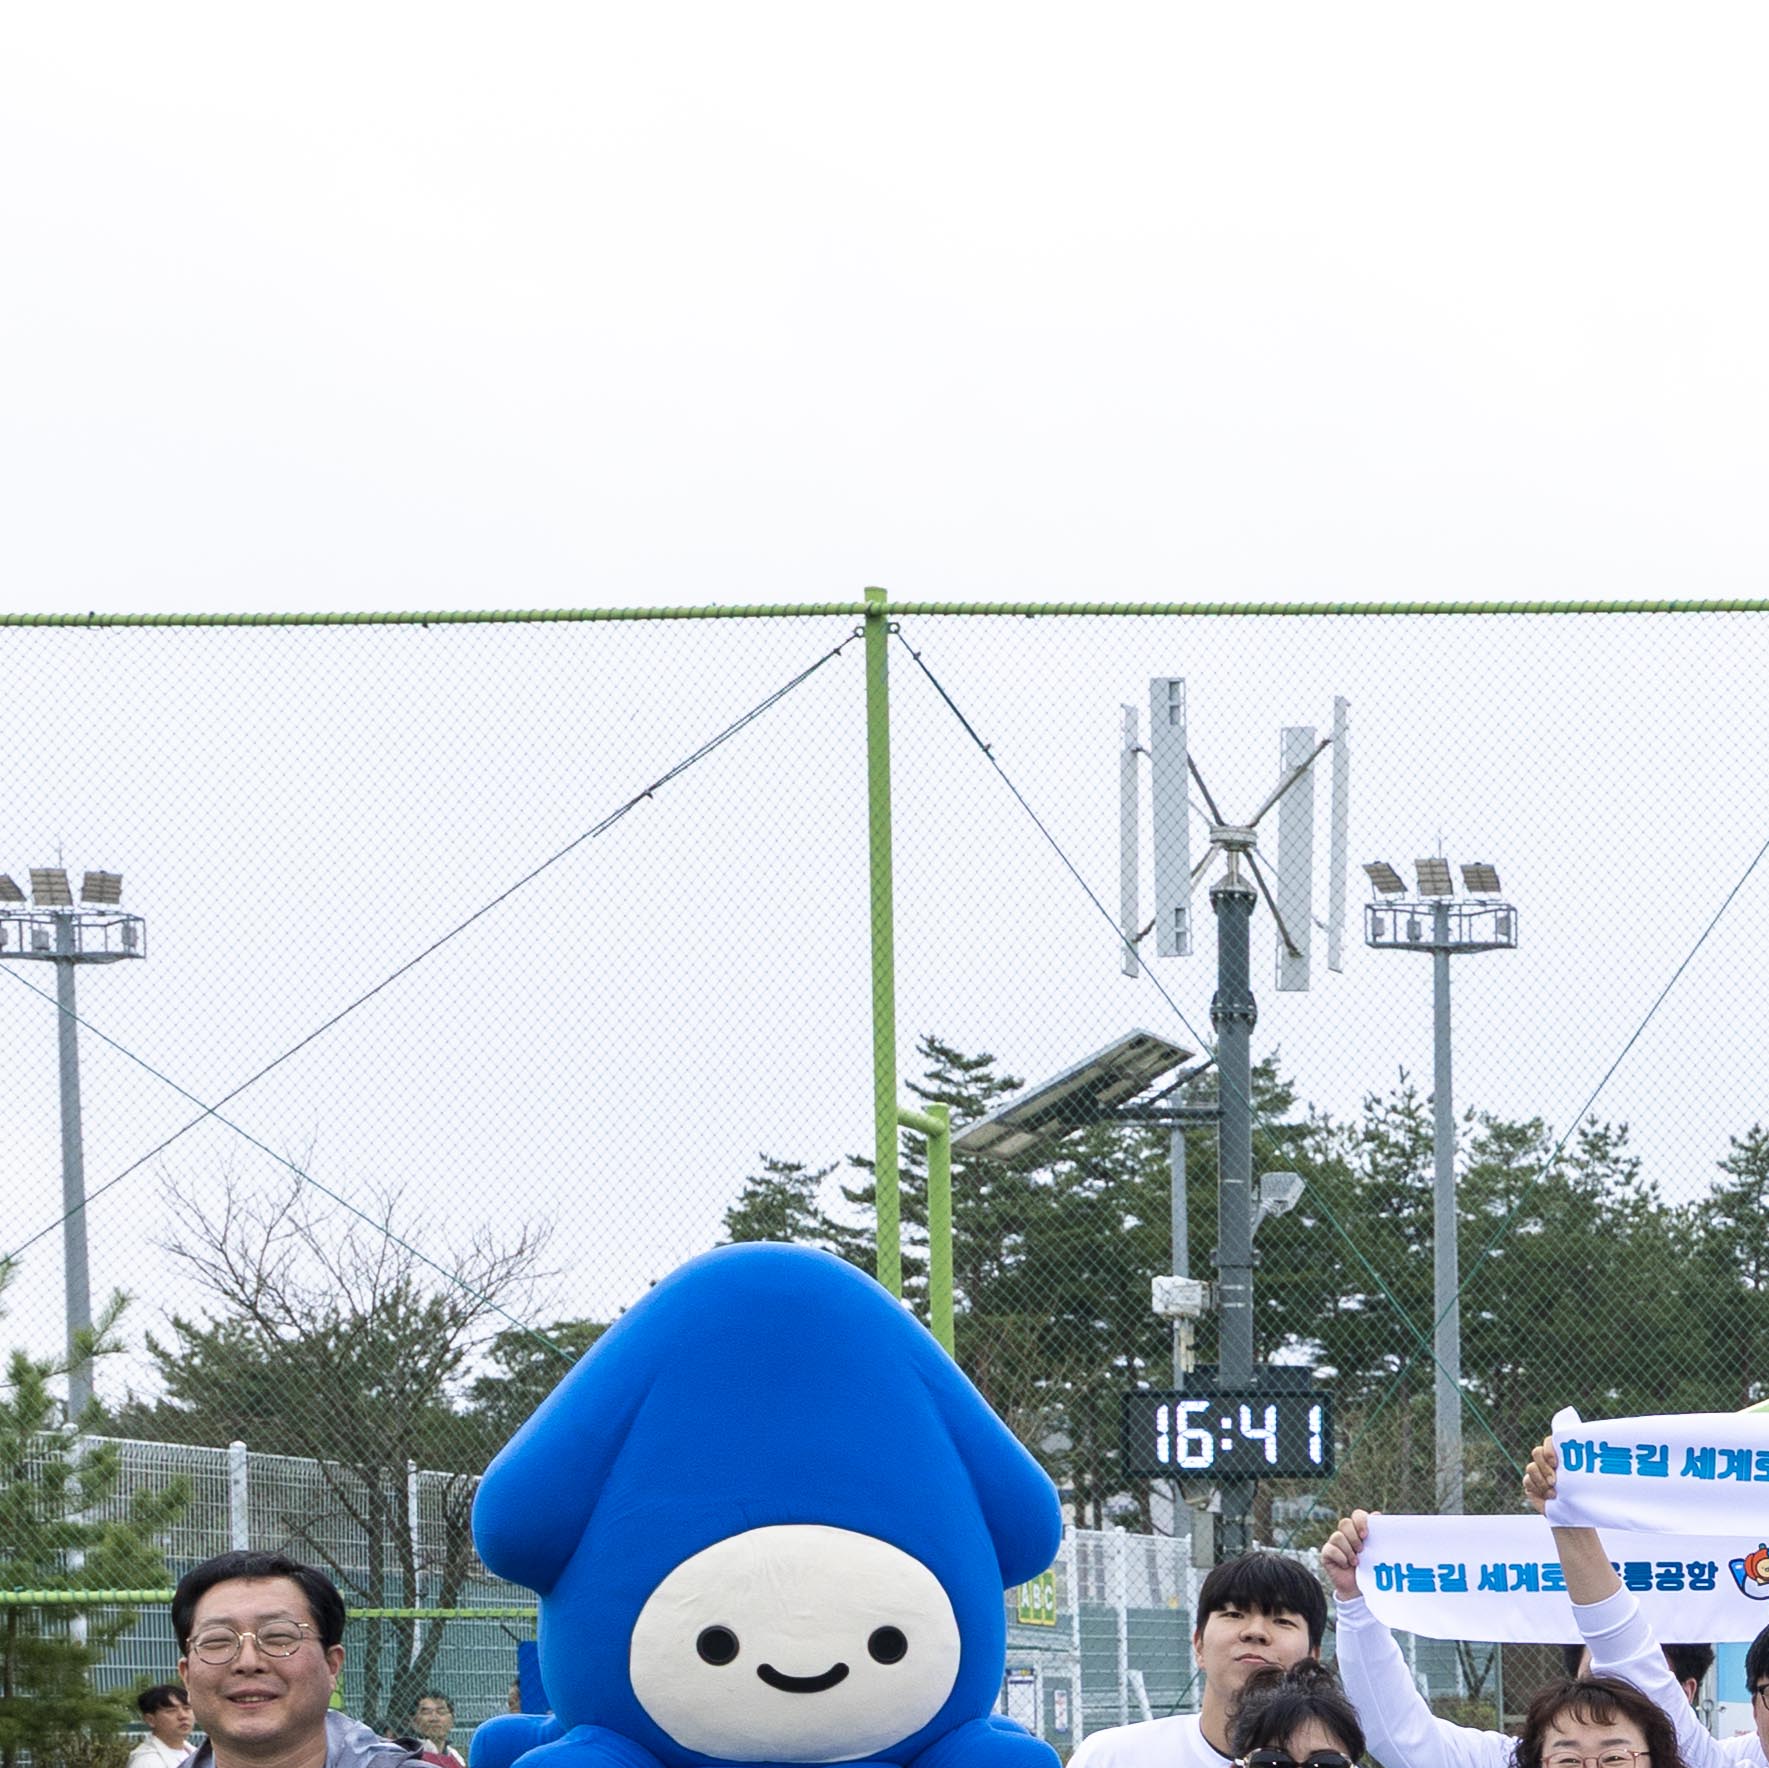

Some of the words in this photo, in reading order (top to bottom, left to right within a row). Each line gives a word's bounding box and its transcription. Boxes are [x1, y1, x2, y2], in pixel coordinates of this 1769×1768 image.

[1156, 1400, 1322, 1468] 16:41
[1560, 1440, 1671, 1480] 하늘길
[1373, 1563, 1470, 1594] 하늘길
[1612, 1561, 1720, 1593] 릉공항
